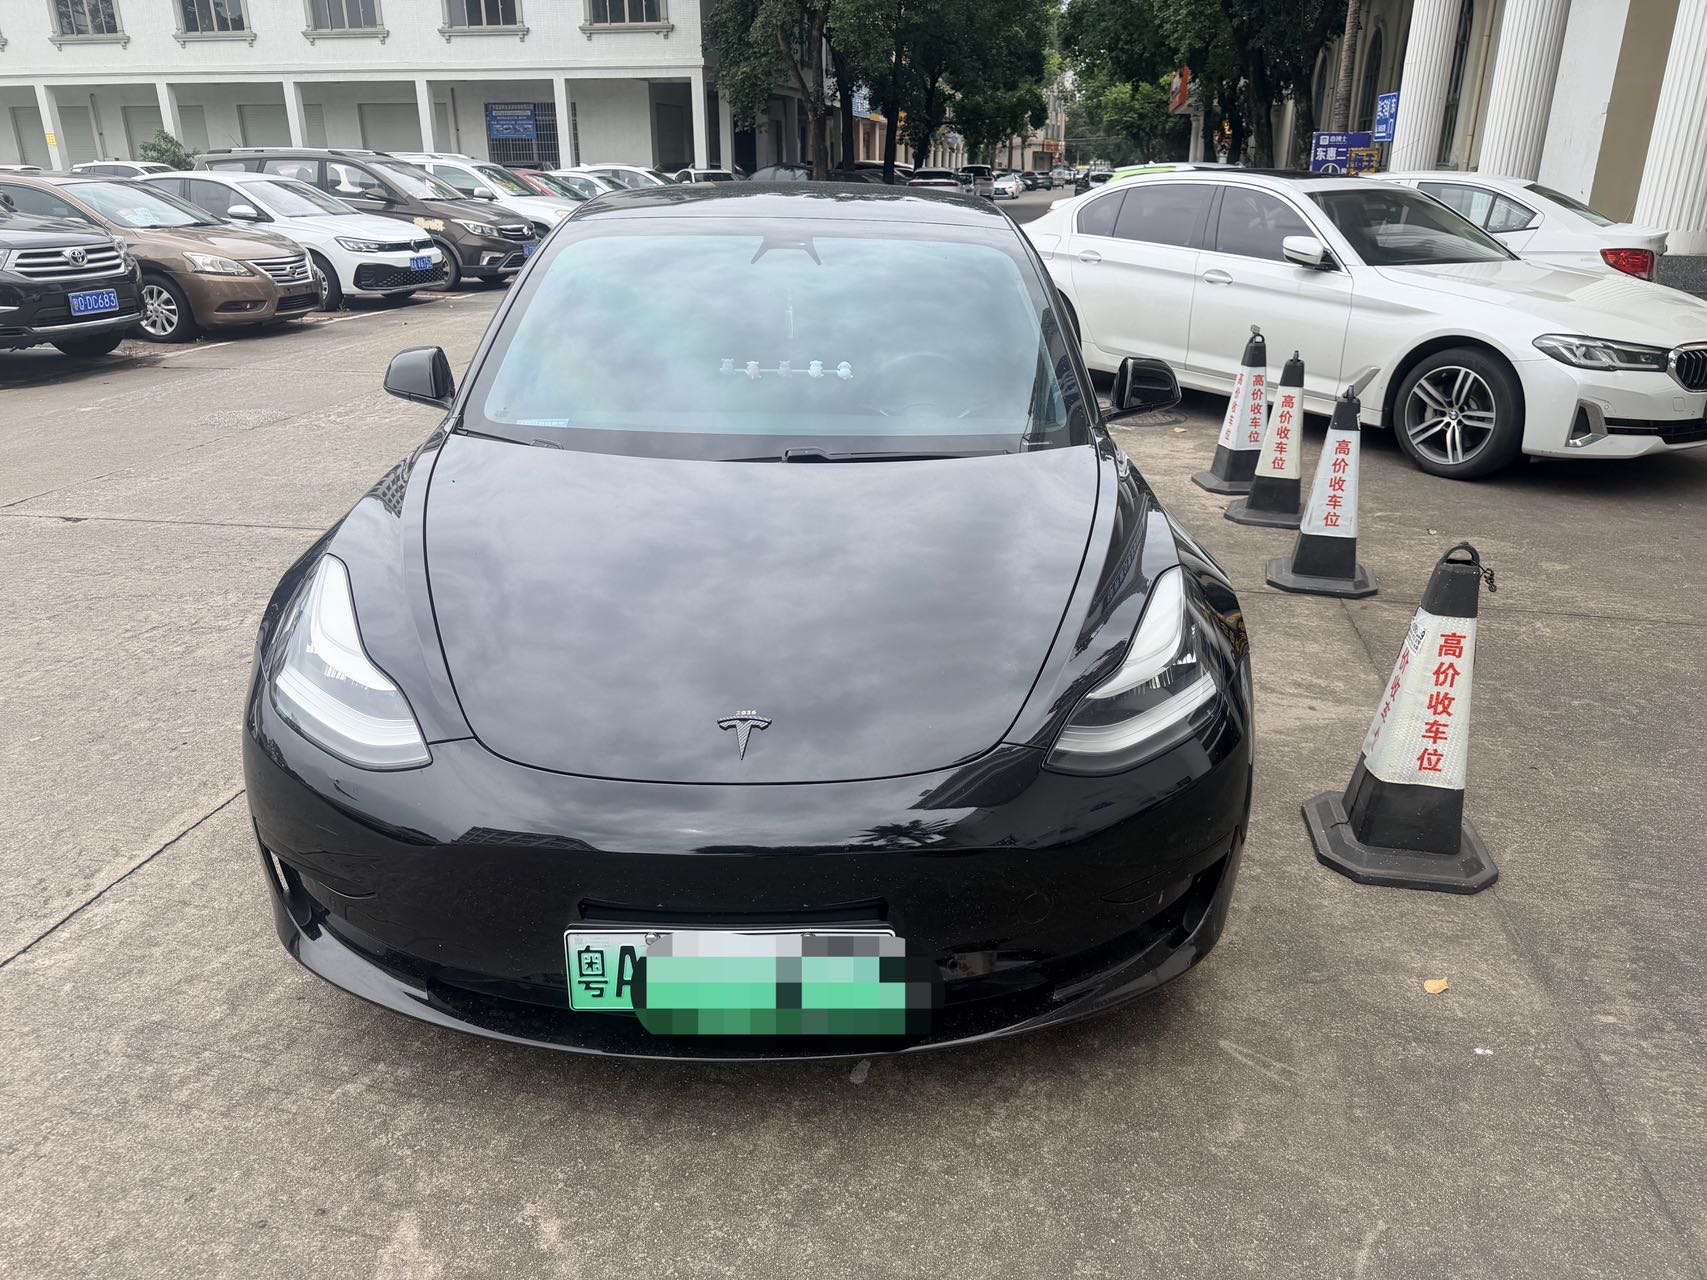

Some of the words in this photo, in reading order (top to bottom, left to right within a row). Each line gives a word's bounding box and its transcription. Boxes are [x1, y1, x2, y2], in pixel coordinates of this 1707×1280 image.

[1315, 147, 1348, 161] 东惠二
[1248, 374, 1265, 443] 高价收车位
[1271, 394, 1297, 470] 高价收车位
[1323, 439, 1352, 528] 高价收车位
[1416, 632, 1467, 773] 高价收车位
